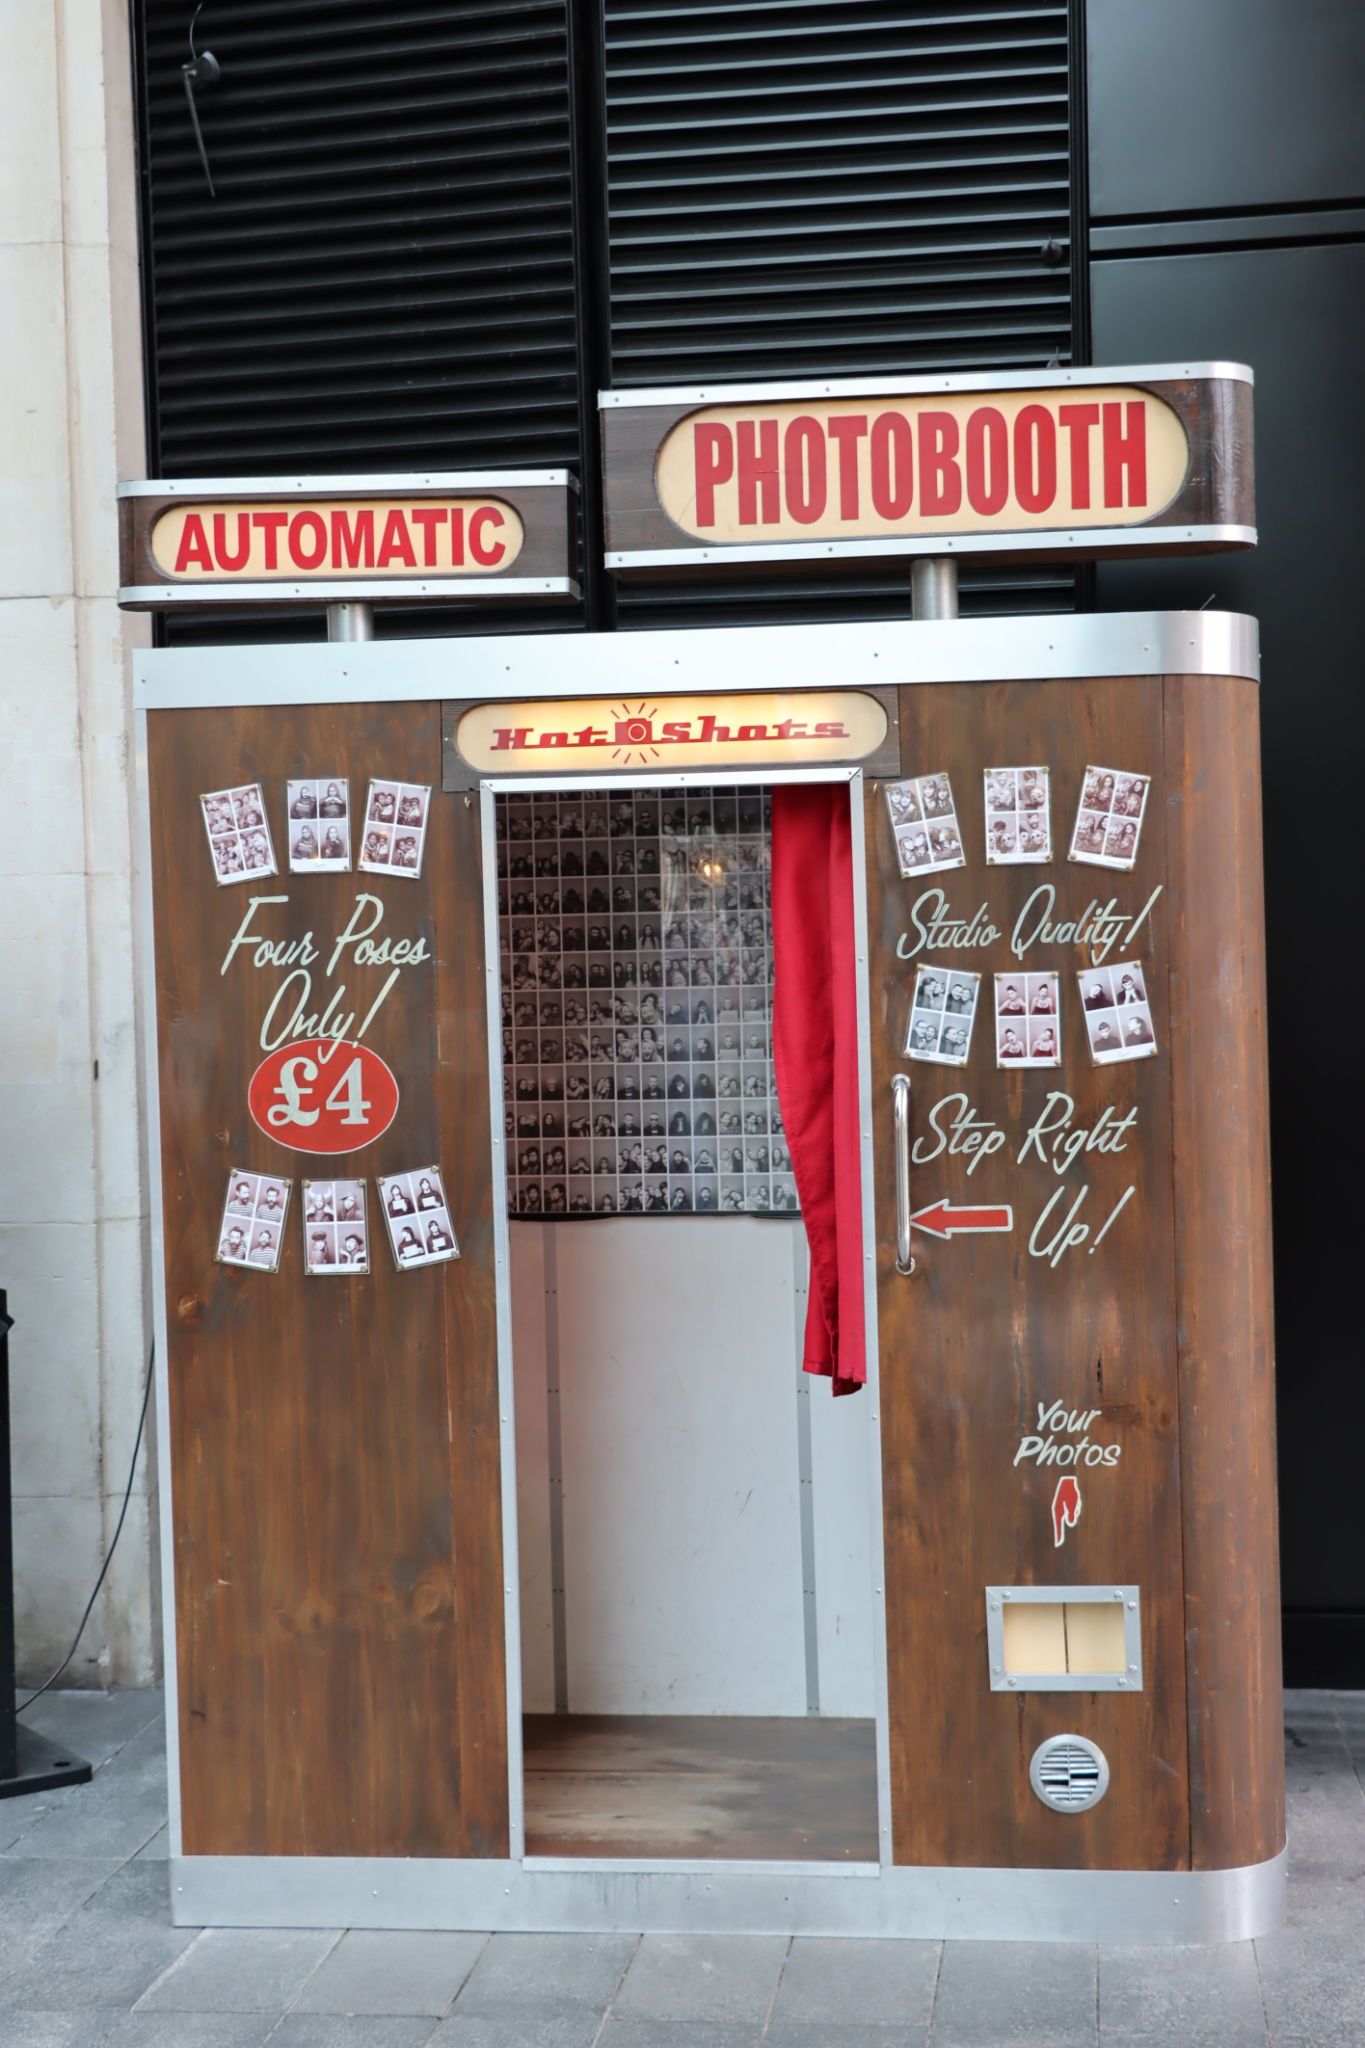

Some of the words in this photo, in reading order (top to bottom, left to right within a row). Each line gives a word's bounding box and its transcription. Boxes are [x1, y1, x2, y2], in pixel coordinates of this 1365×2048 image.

[693, 401, 1148, 528] PHOTOBOOTH
[174, 506, 506, 573] AUTOMATIC
[489, 727, 608, 751] Hot
[220, 895, 319, 976] Four
[326, 892, 431, 977] Poses
[896, 888, 1002, 960] Studio
[1010, 884, 1163, 966] Quality!
[259, 967, 400, 1065] Only!
[266, 1056, 372, 1127] £4
[911, 1092, 1006, 1176] Step
[1016, 1091, 1139, 1175] Right
[1028, 1185, 1136, 1268] Up!
[1013, 1435, 1121, 1467] Photos
[1036, 1399, 1102, 1433] Your
